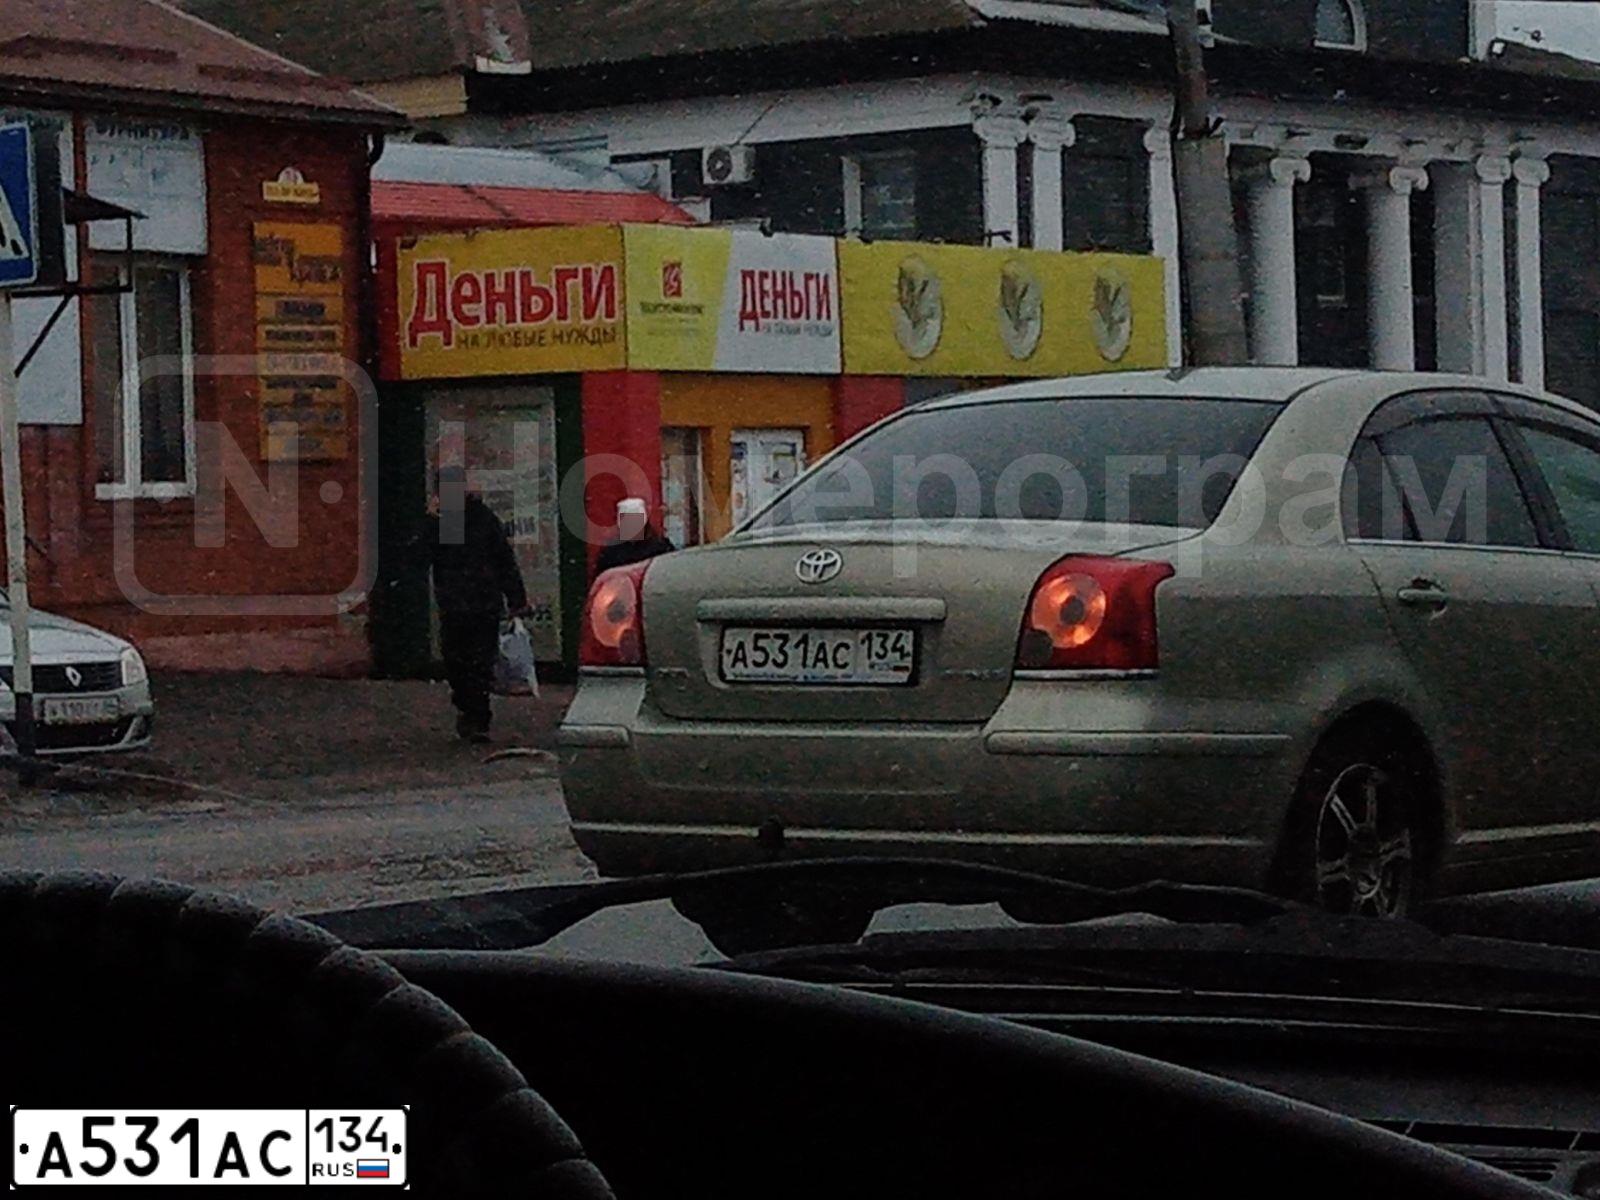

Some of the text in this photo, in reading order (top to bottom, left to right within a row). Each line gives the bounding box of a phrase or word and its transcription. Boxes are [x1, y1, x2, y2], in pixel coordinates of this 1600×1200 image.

[408, 262, 618, 348] Деньги
[739, 269, 832, 332] ДЕНЬГИ
[458, 333, 480, 348] НА
[552, 326, 617, 347] НУЖДЫ
